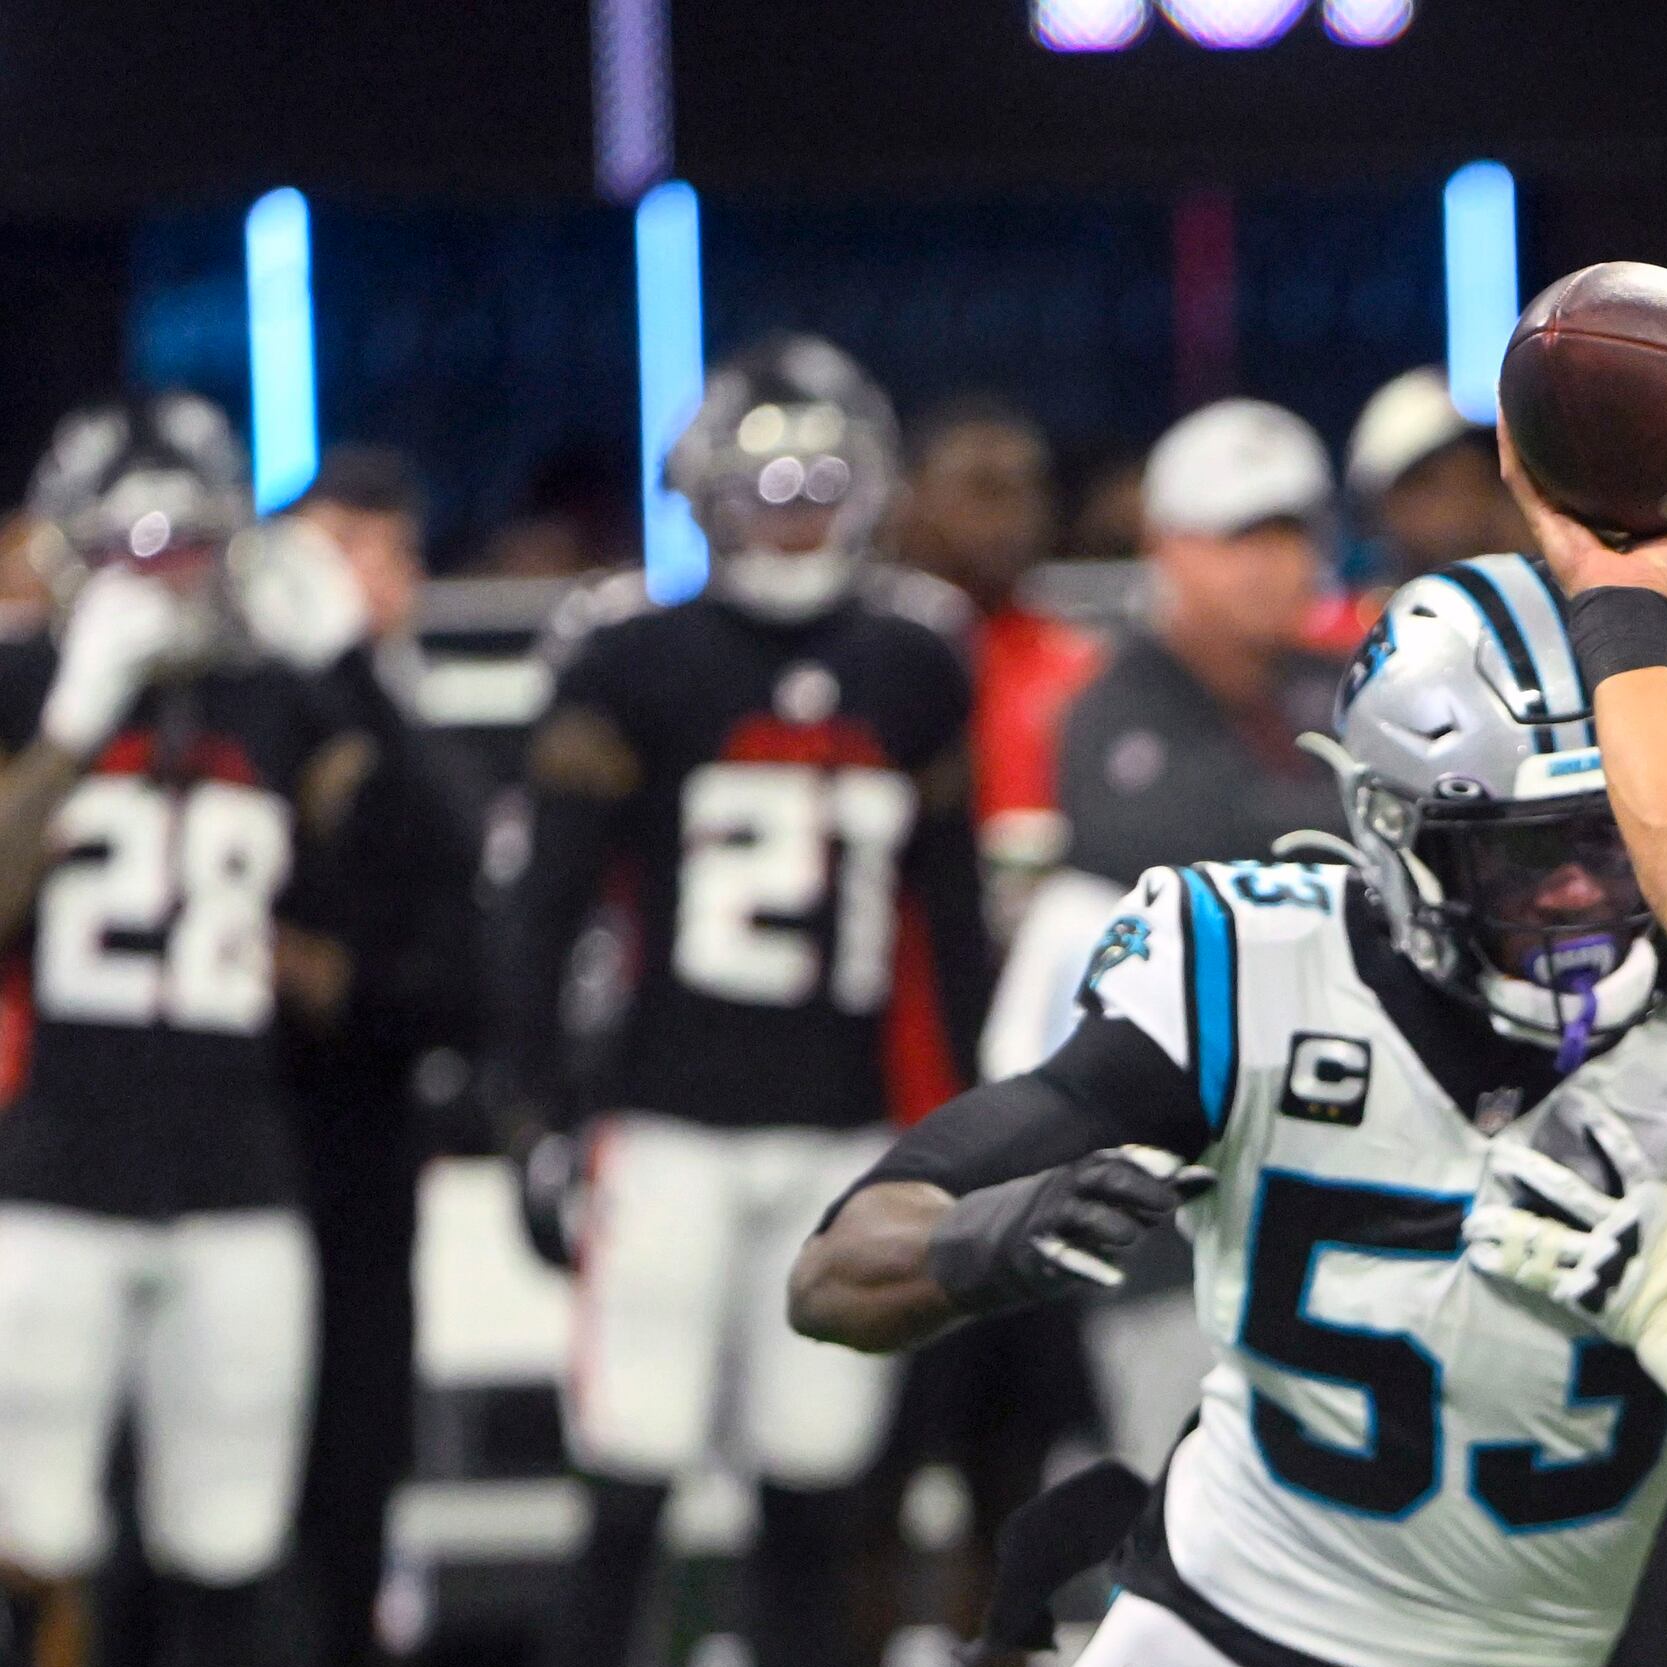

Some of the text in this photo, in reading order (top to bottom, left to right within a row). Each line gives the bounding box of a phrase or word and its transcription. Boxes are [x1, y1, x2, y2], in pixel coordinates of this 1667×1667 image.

[33, 772, 292, 1034] 28
[672, 762, 916, 1014] 21
[1290, 1037, 1369, 1104] C
